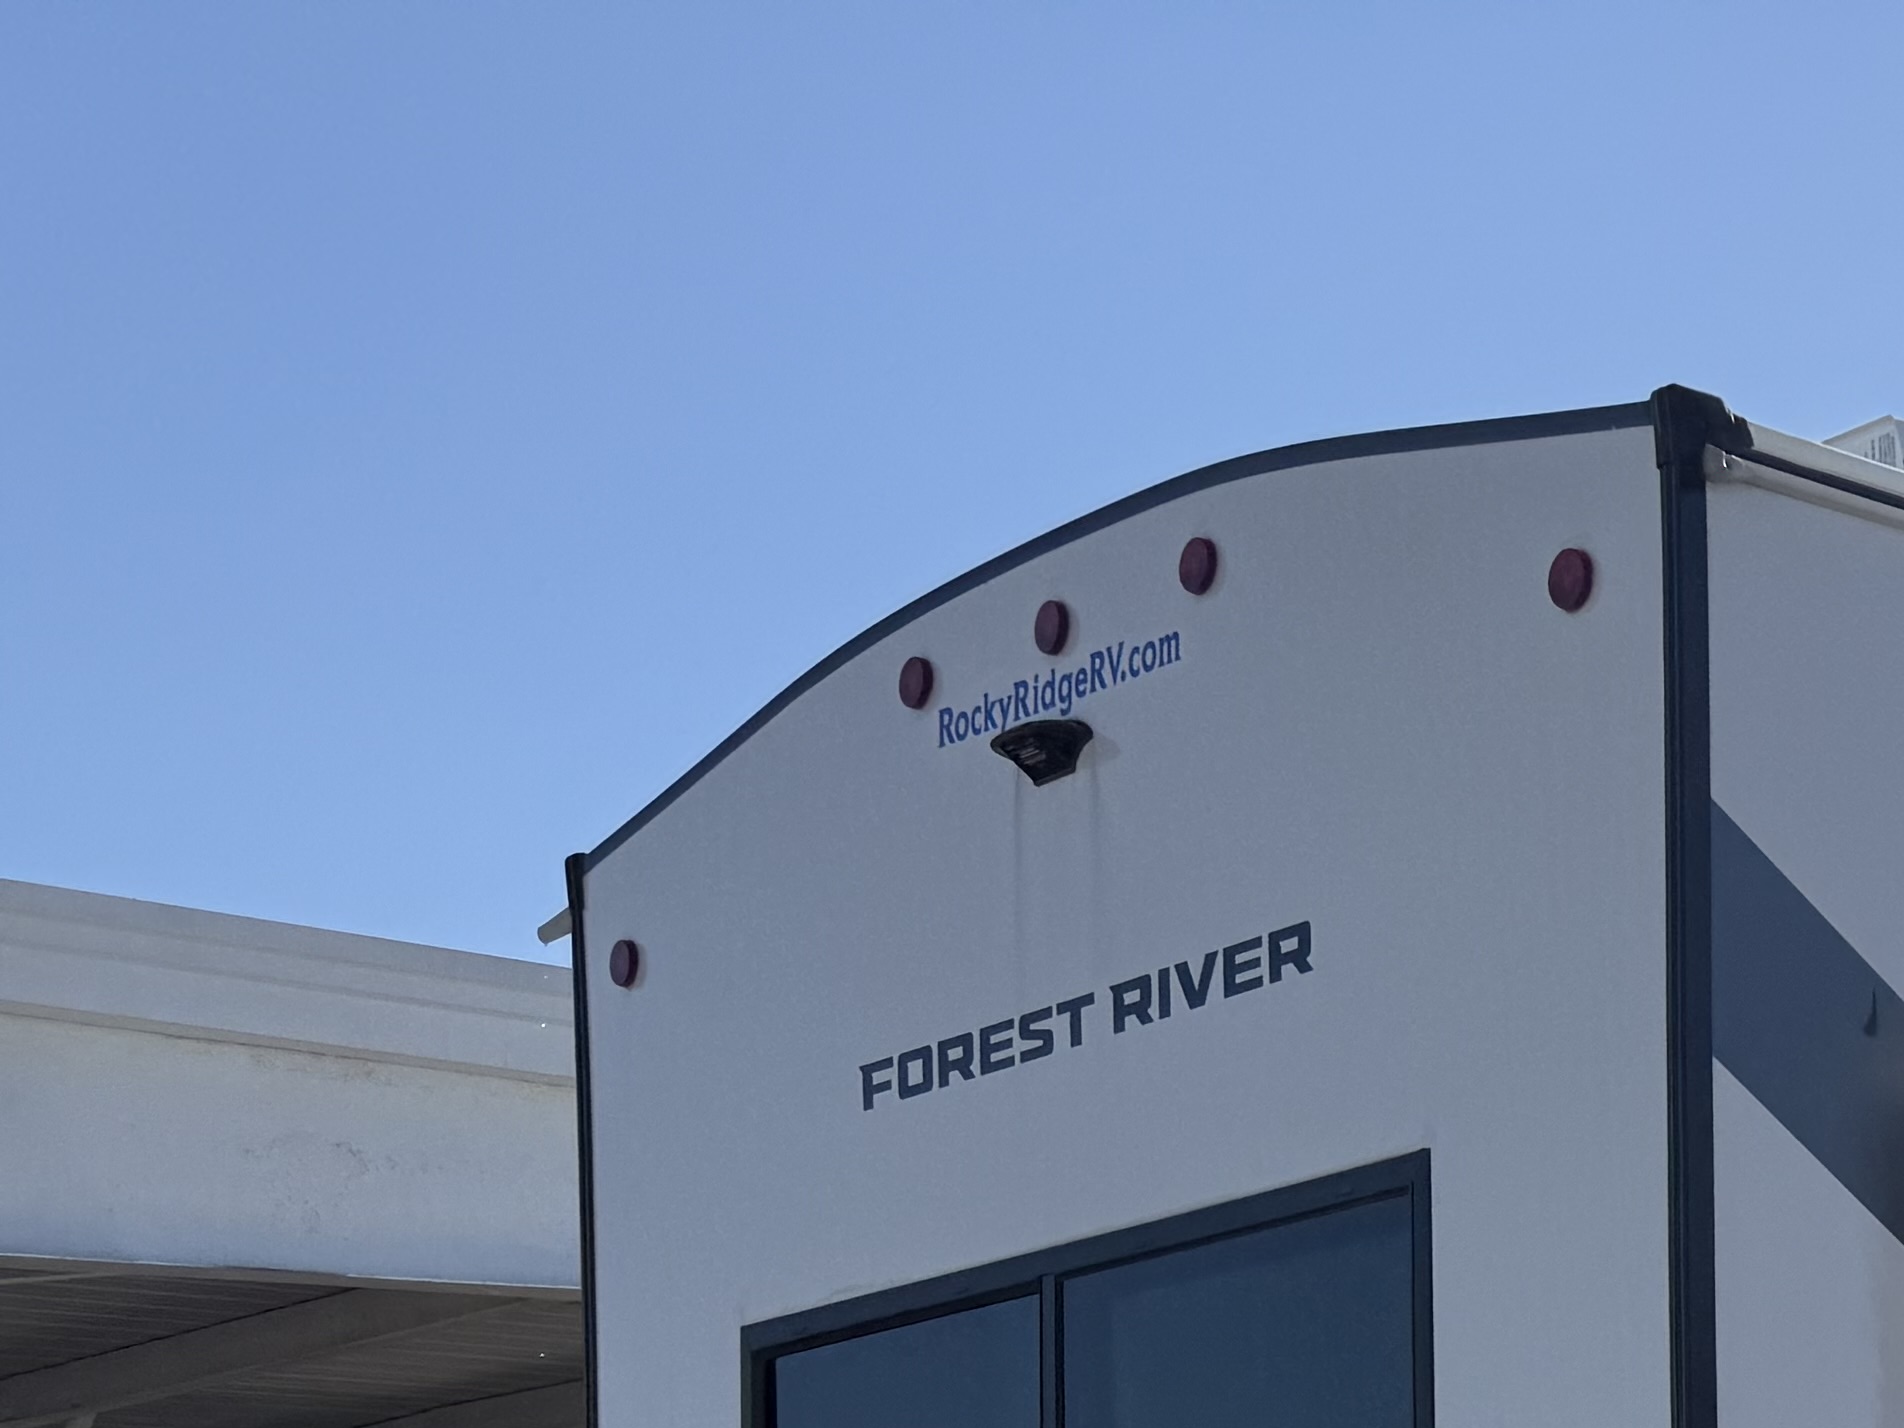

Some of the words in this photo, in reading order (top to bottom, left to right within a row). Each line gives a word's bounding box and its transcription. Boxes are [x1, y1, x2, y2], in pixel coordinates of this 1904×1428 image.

[938, 630, 1182, 748] RockyRidgeRV.com
[859, 993, 1095, 1111] FOREST
[1110, 920, 1314, 1034] RIVER
